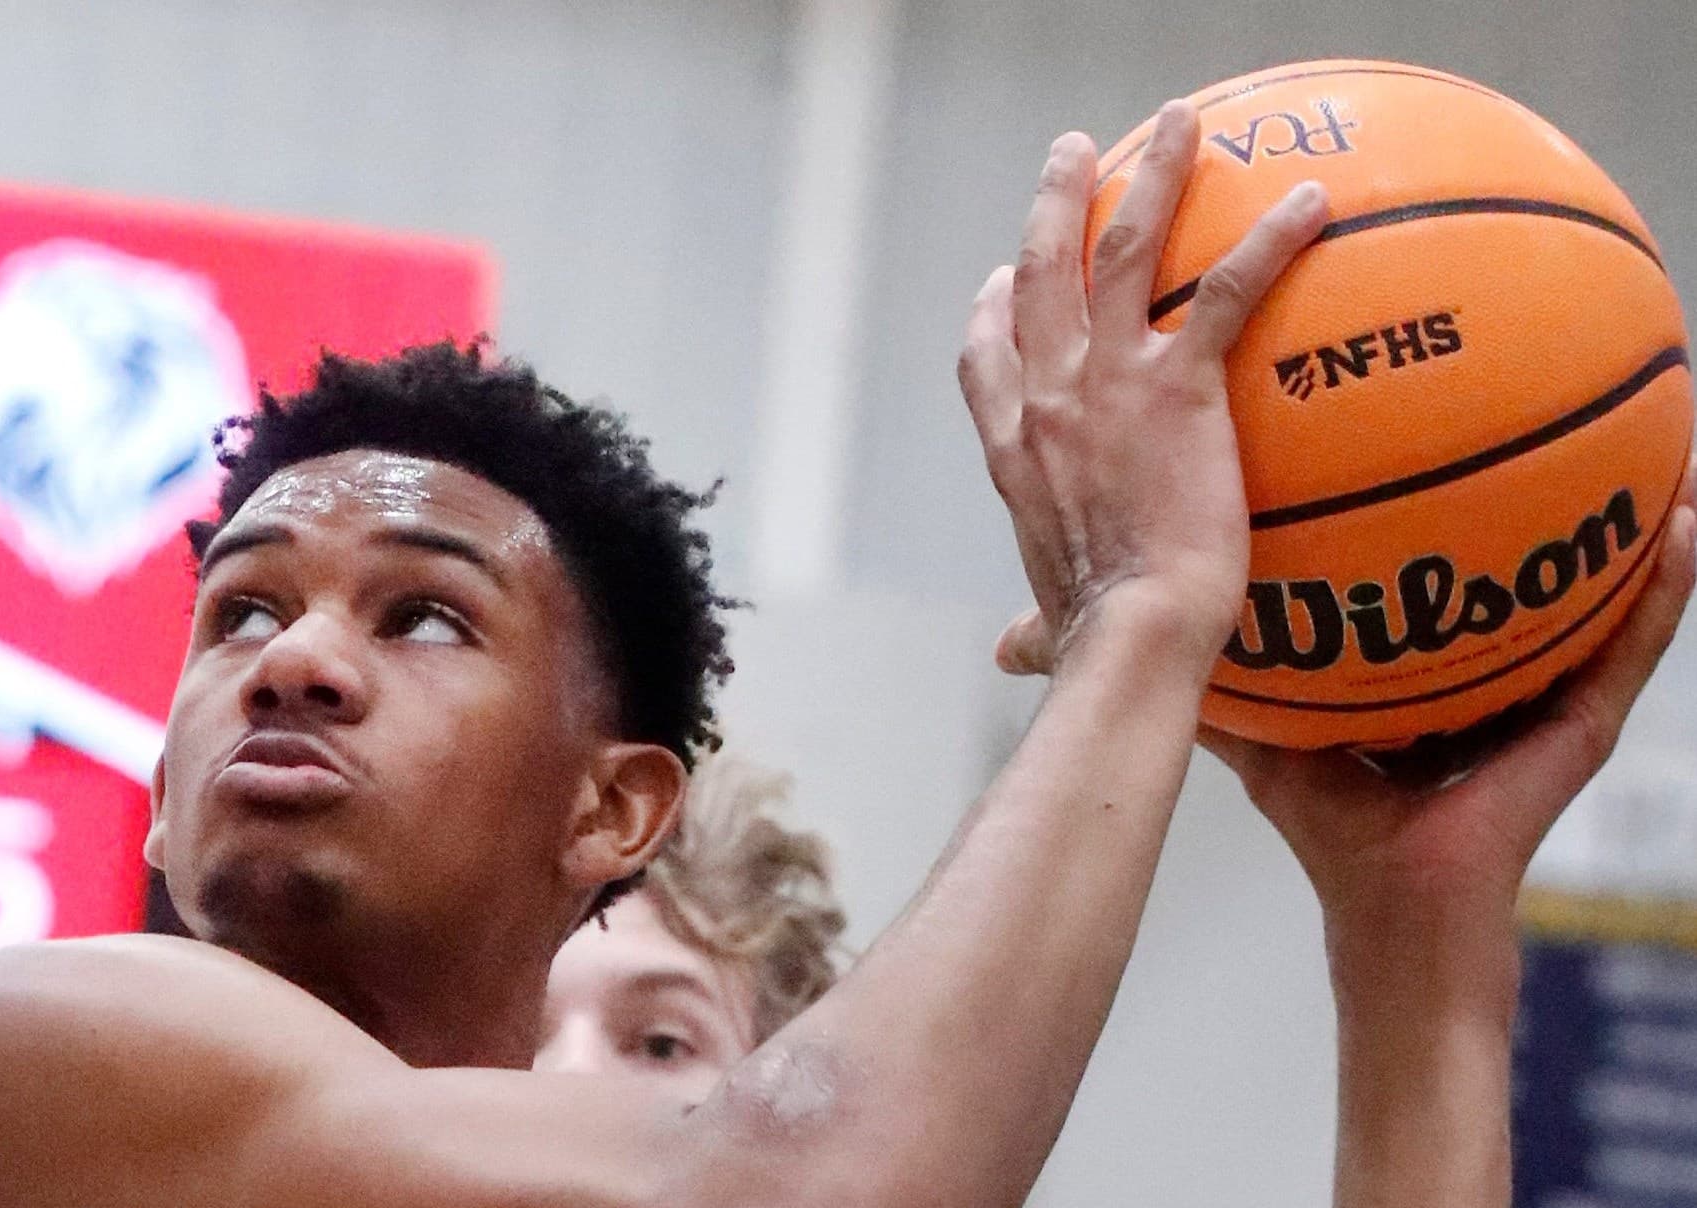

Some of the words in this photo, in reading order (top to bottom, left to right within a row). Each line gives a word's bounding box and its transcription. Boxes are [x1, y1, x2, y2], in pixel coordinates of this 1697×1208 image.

[1209, 97, 1357, 166] PCA
[1315, 311, 1463, 389] NFHS
[1220, 488, 1640, 671] Wilson
